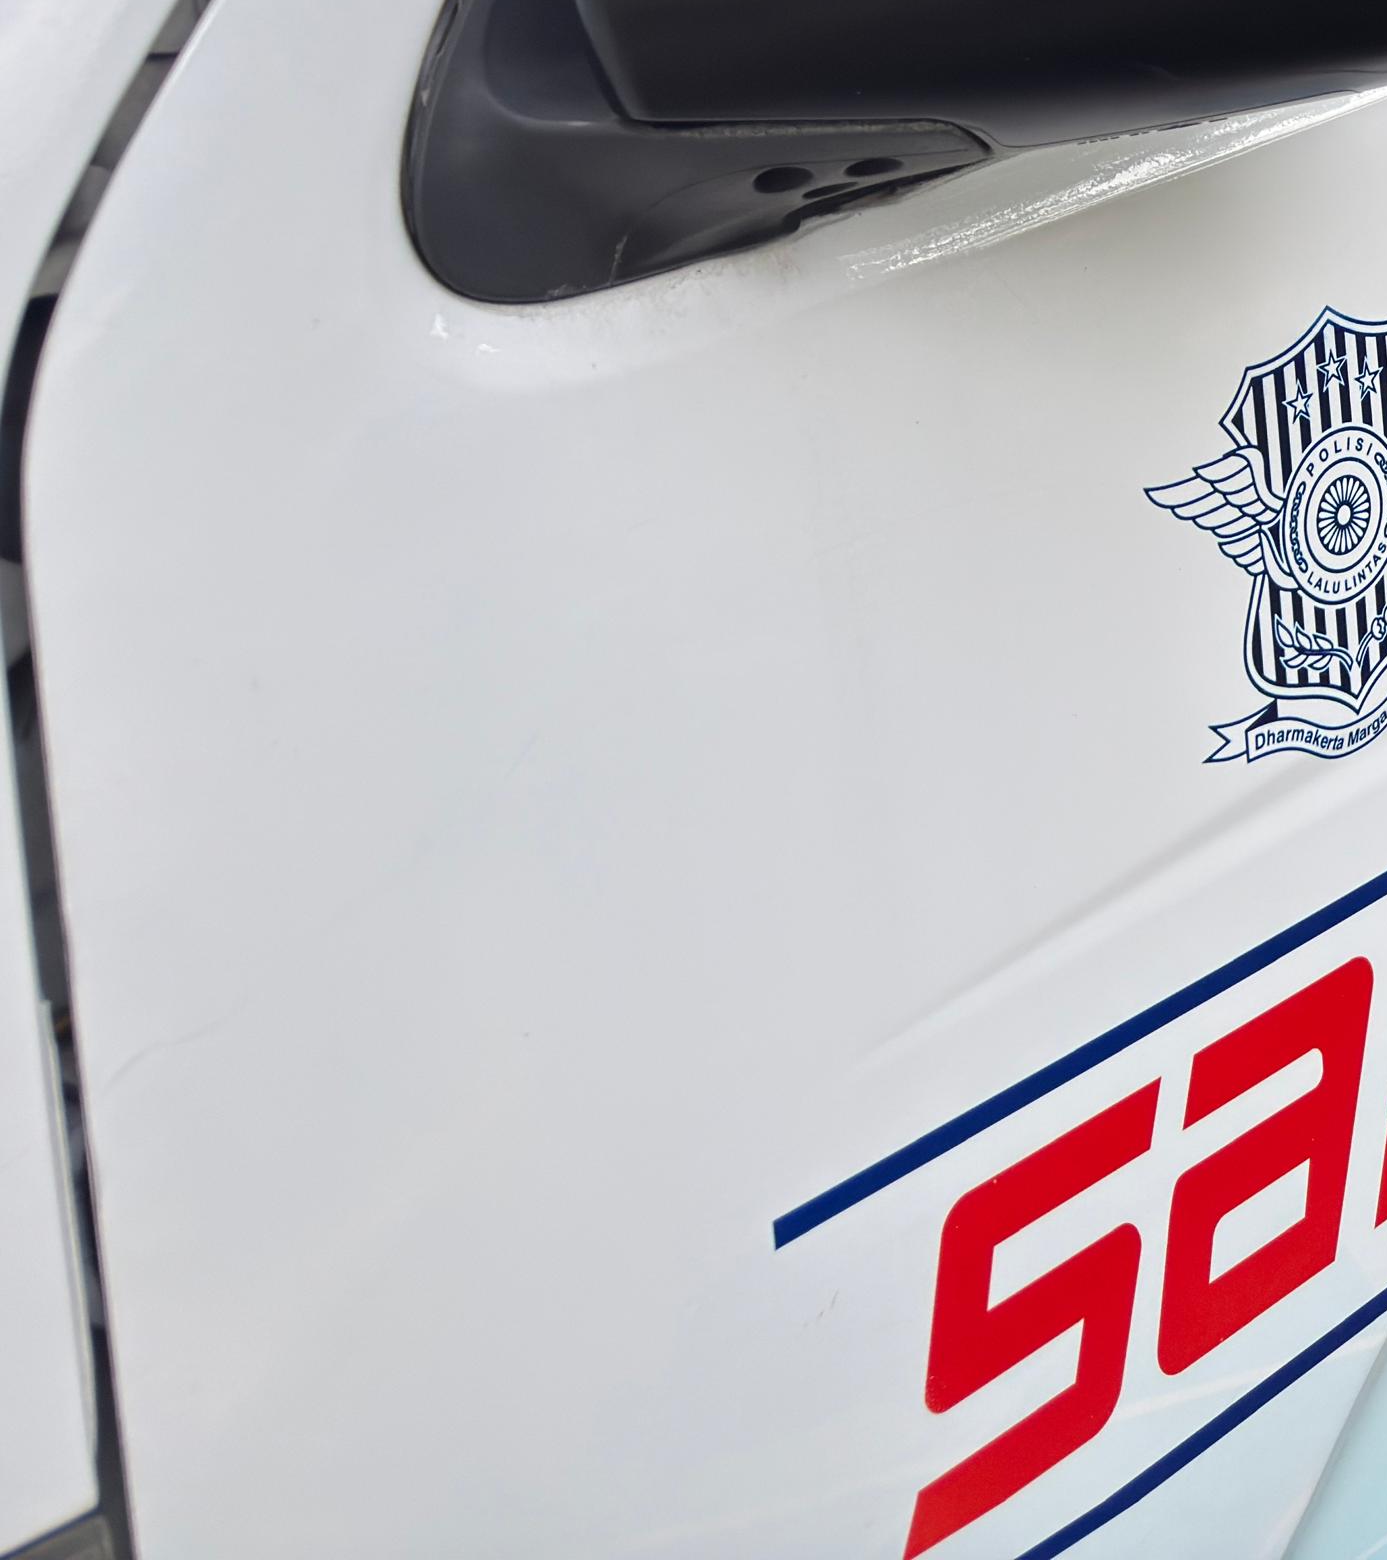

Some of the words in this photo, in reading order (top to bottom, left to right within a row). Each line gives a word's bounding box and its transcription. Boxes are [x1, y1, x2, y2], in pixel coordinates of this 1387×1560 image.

[1306, 437, 1372, 477] POLISI
[1306, 573, 1342, 595] LALU
[1344, 542, 1387, 592] LINTAS
[1254, 725, 1345, 752] Dharmakerta
[1347, 711, 1387, 748] Marga
